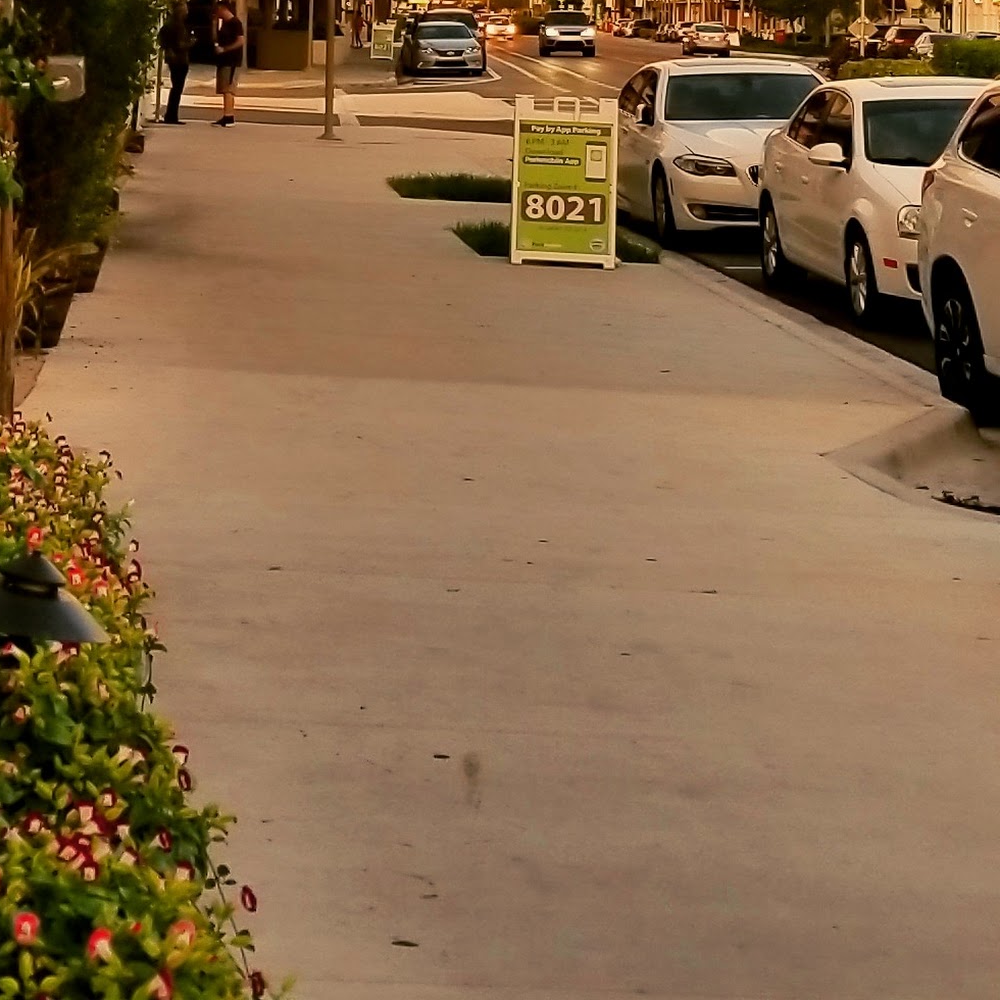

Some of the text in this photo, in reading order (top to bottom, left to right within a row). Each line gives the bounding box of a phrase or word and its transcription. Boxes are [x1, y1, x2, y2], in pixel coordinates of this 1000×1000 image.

[531, 124, 602, 136] Pay by App Parking
[525, 194, 602, 222] 8021
